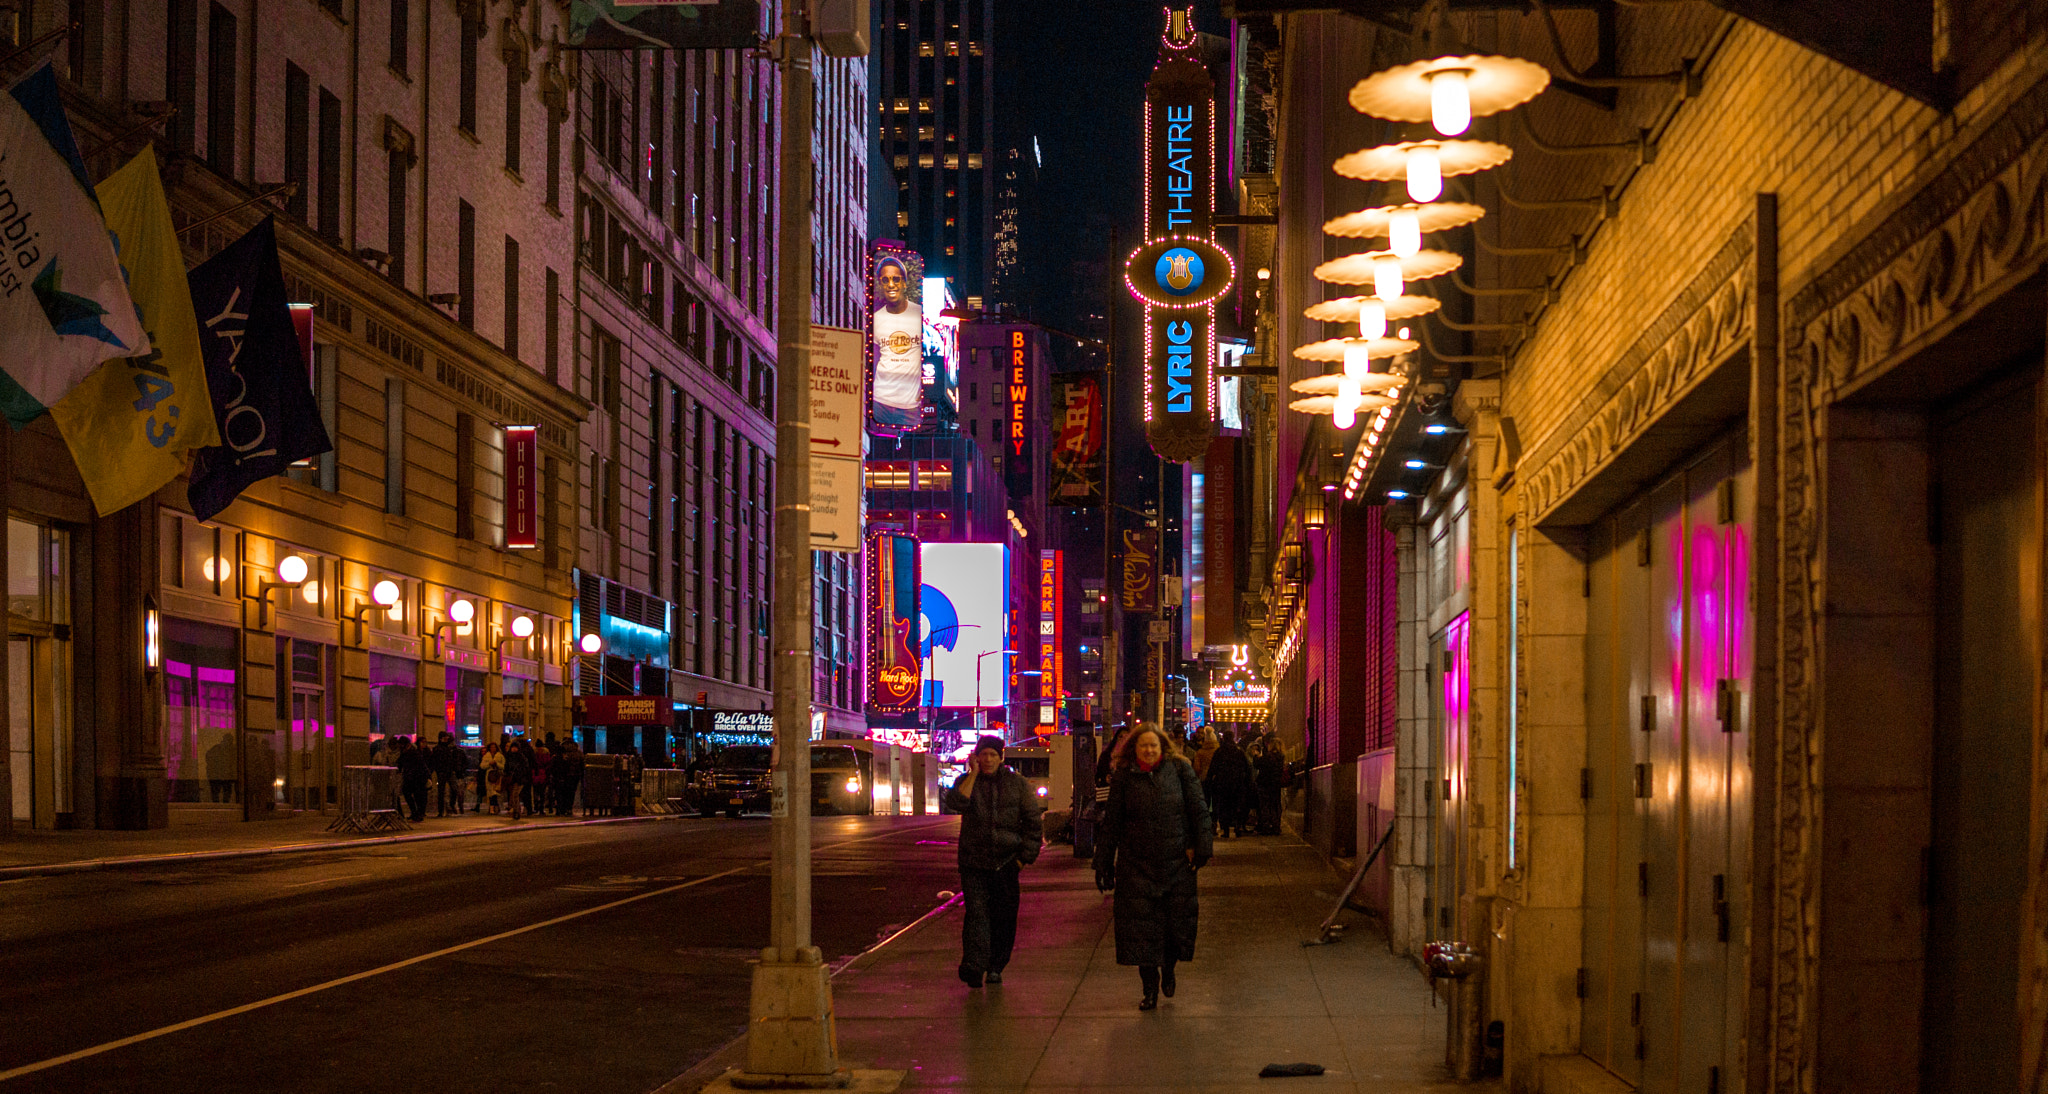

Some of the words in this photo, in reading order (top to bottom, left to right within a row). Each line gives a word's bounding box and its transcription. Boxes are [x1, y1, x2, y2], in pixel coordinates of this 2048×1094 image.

[1168, 105, 1193, 230] THEATRE
[0, 178, 40, 270] mbia
[0, 236, 23, 298] rust
[811, 348, 836, 359] parking
[812, 331, 826, 339] hour
[812, 340, 839, 350] metered
[881, 336, 900, 348] Hard
[900, 334, 920, 347] Rock
[835, 381, 859, 395] ONLY
[1167, 320, 1193, 413] LYRIC
[813, 408, 840, 423] Sunday
[1010, 331, 1028, 456] BREWERY
[1064, 383, 1089, 456] ART
[517, 441, 526, 534] HARU
[811, 504, 838, 517] Sunday
[1214, 464, 1225, 520] REUTERS
[1123, 529, 1150, 608] Aladdin
[1214, 524, 1225, 586] THOMSON
[1041, 559, 1054, 612] PARK
[1010, 609, 1019, 686] TONY'S
[1041, 644, 1054, 697] PARK
[617, 700, 656, 708] SPANISH
[879, 670, 899, 683] Hard
[899, 671, 918, 685] Rock
[714, 712, 748, 724] Bella
